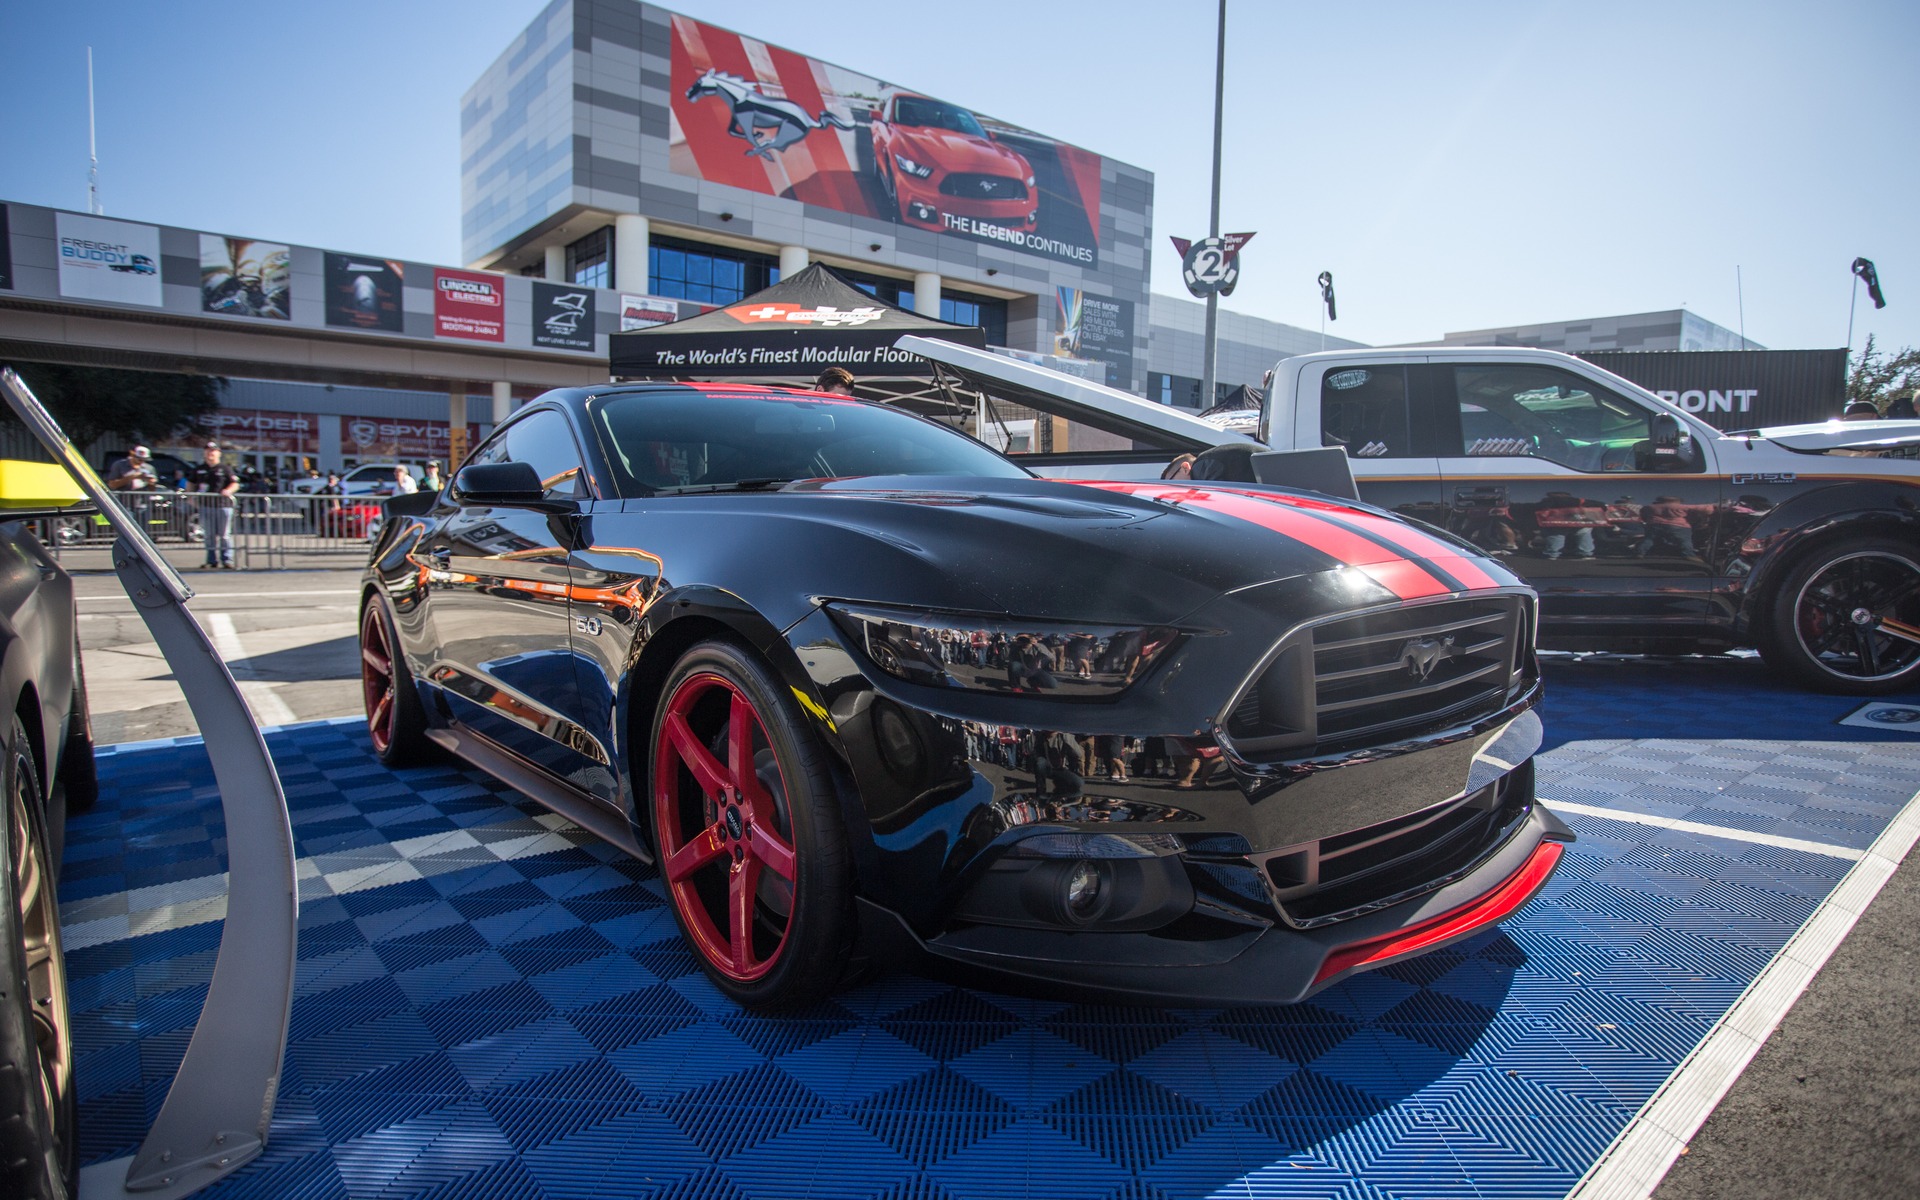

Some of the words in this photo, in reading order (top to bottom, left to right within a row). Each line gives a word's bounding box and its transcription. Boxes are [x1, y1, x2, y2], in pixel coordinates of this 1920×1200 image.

[61, 237, 128, 253] FREIGHT
[942, 213, 969, 232] THE
[971, 220, 1025, 245] LEGEND
[1026, 235, 1093, 262] CONTINUES
[1224, 235, 1243, 244] Silver
[62, 246, 127, 263] BUDDY
[1201, 251, 1220, 277] 2
[441, 280, 490, 295] LINCOLN
[453, 291, 495, 304] ELECTRIC
[1083, 298, 1101, 309] DRIVE
[1102, 302, 1119, 313] MORE
[1083, 307, 1101, 317] SALES
[1102, 310, 1117, 319] WITH
[1094, 317, 1117, 328] MILLION
[1082, 323, 1102, 334] ACTIVE
[1103, 326, 1125, 338] BUYERS
[1082, 332, 1091, 340] ON
[656, 350, 685, 364] The
[689, 348, 747, 364] World's
[750, 347, 799, 363] Finest
[800, 346, 870, 363] Modular
[1650, 389, 1758, 413] RONT
[199, 414, 309, 431] SPYDER
